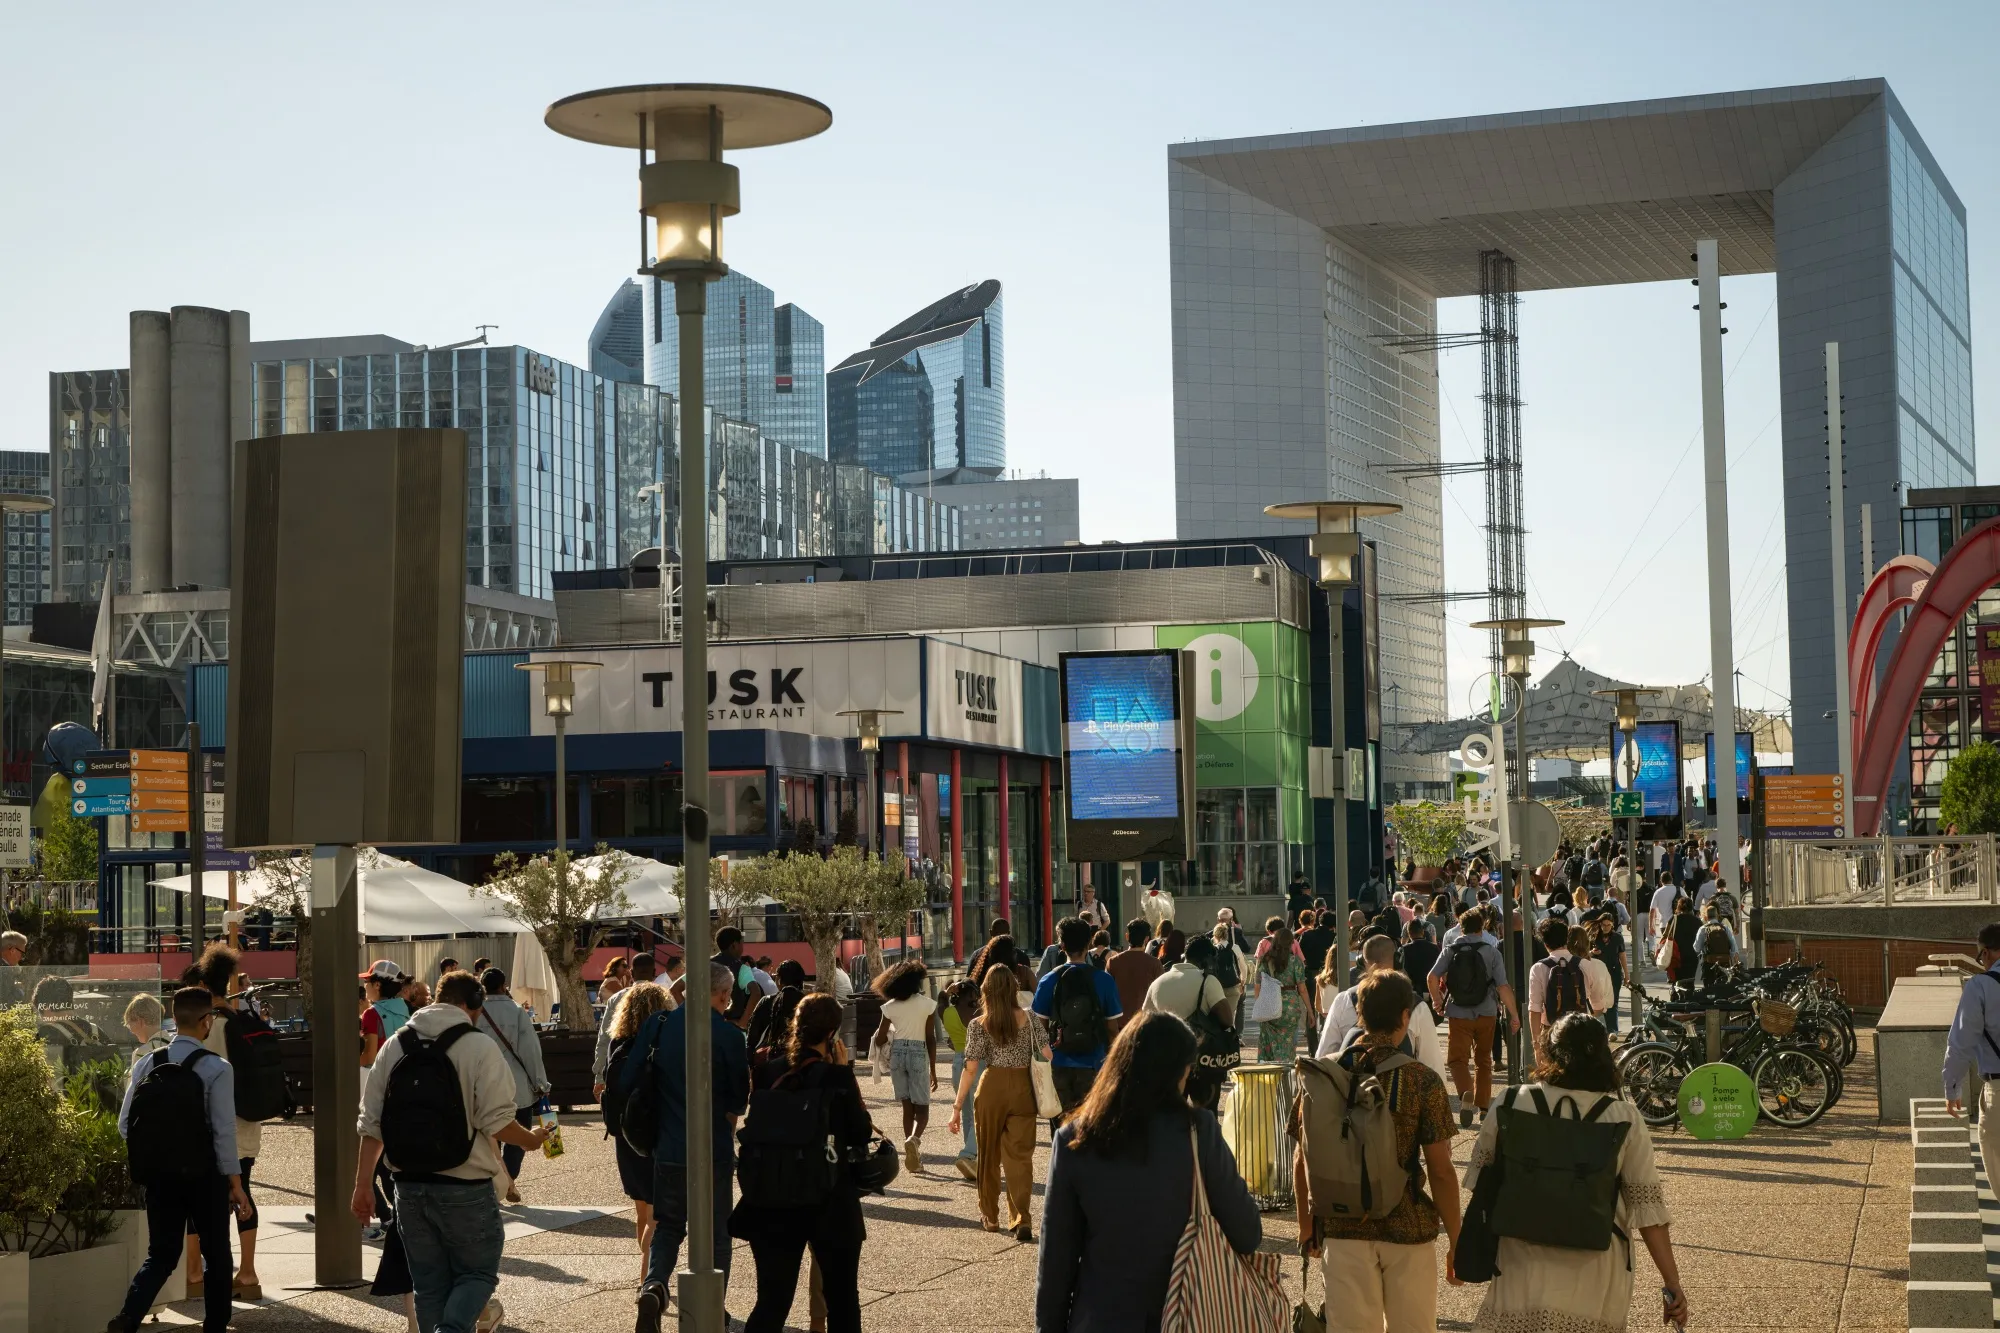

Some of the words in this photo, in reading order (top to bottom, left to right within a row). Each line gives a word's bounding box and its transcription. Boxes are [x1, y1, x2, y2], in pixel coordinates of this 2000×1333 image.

[642, 667, 806, 708] TSK
[955, 669, 998, 711] TUSK
[708, 706, 805, 721] STAURANT
[965, 709, 997, 724] RESTAURANT
[1103, 721, 1160, 732] PlayStation
[91, 762, 114, 770] Secteur
[1204, 760, 1234, 769] Défense
[91, 805, 124, 813] Atlantique,
[37, 1002, 89, 1011] REMERCIONS
[1199, 1051, 1240, 1068] adidas
[1713, 1087, 1739, 1095] Pompe
